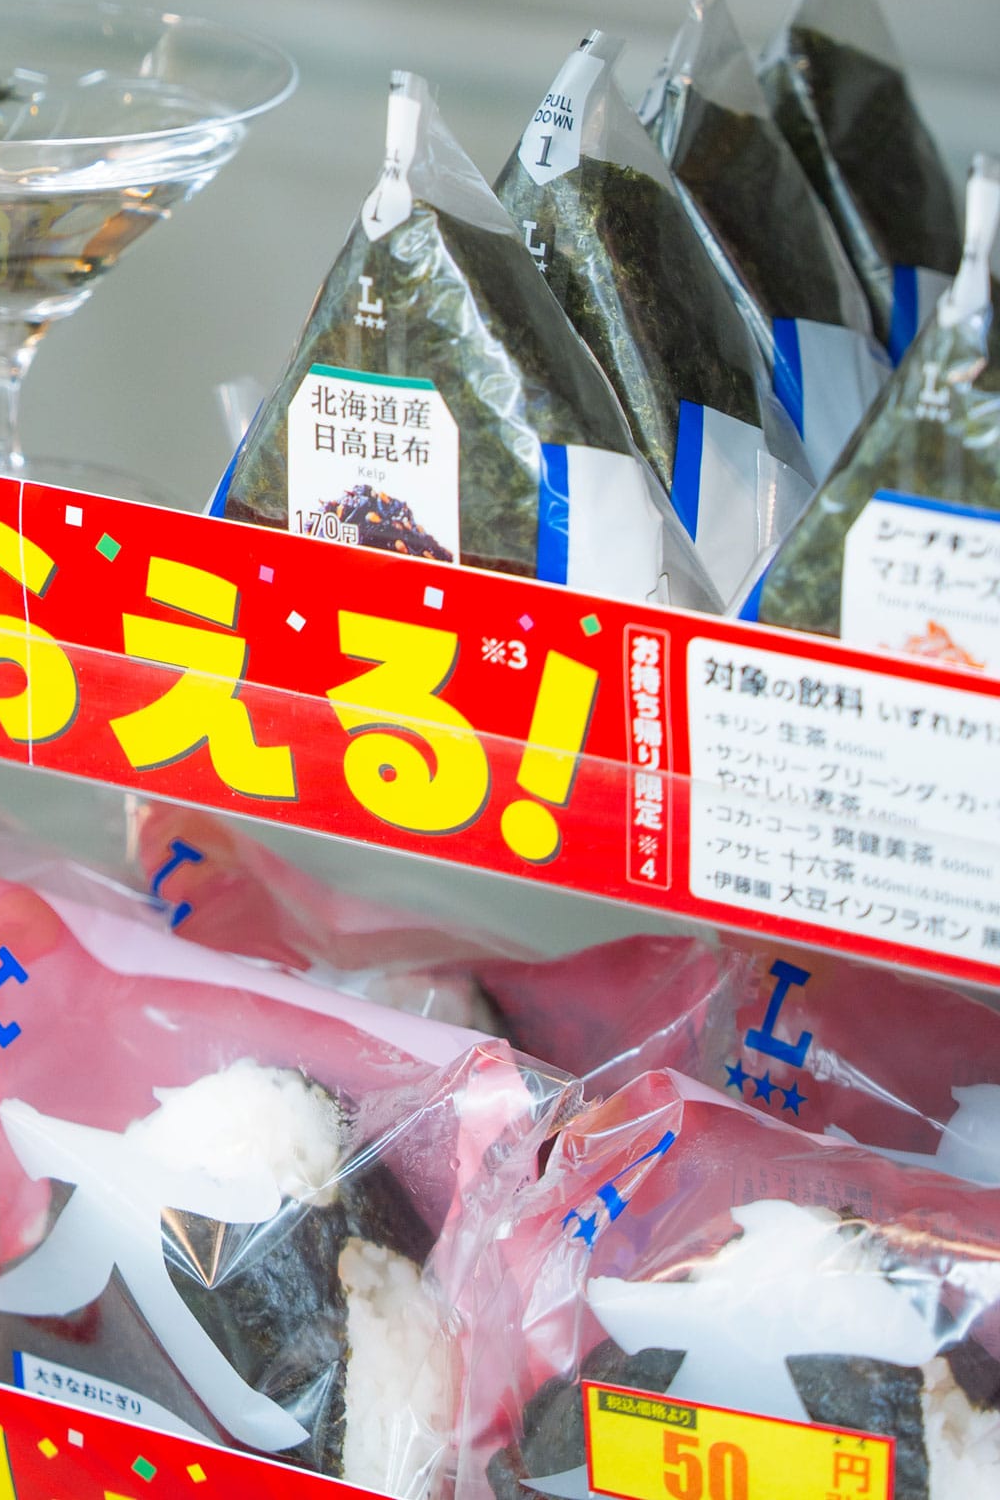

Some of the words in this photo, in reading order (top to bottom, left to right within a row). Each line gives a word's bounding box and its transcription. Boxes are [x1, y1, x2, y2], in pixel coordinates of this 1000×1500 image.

[534, 109, 575, 132] DOWN
[544, 92, 574, 114] PULL
[535, 135, 553, 168] 1
[310, 384, 432, 431] 北海道産
[314, 422, 432, 467] 日高昆布
[357, 464, 387, 483] Kelp
[294, 508, 360, 546] 170円
[481, 633, 529, 671] ※3
[704, 656, 864, 718] 対象の飲料
[631, 635, 665, 831] お持ち帰り限定
[778, 719, 827, 749] 生茶
[716, 767, 861, 822] やさしい麦茶
[638, 833, 659, 881] ※4
[780, 848, 855, 885] 十六茶
[832, 823, 936, 868] 爽健美茶
[780, 880, 971, 942] 大豆イソフラボン
[744, 958, 813, 1068] L
[32, 1365, 143, 1415] 大きなおにぎり
[604, 1394, 693, 1428] 税込価格より
[662, 1429, 750, 1500] 50
[833, 1451, 872, 1495] 円
